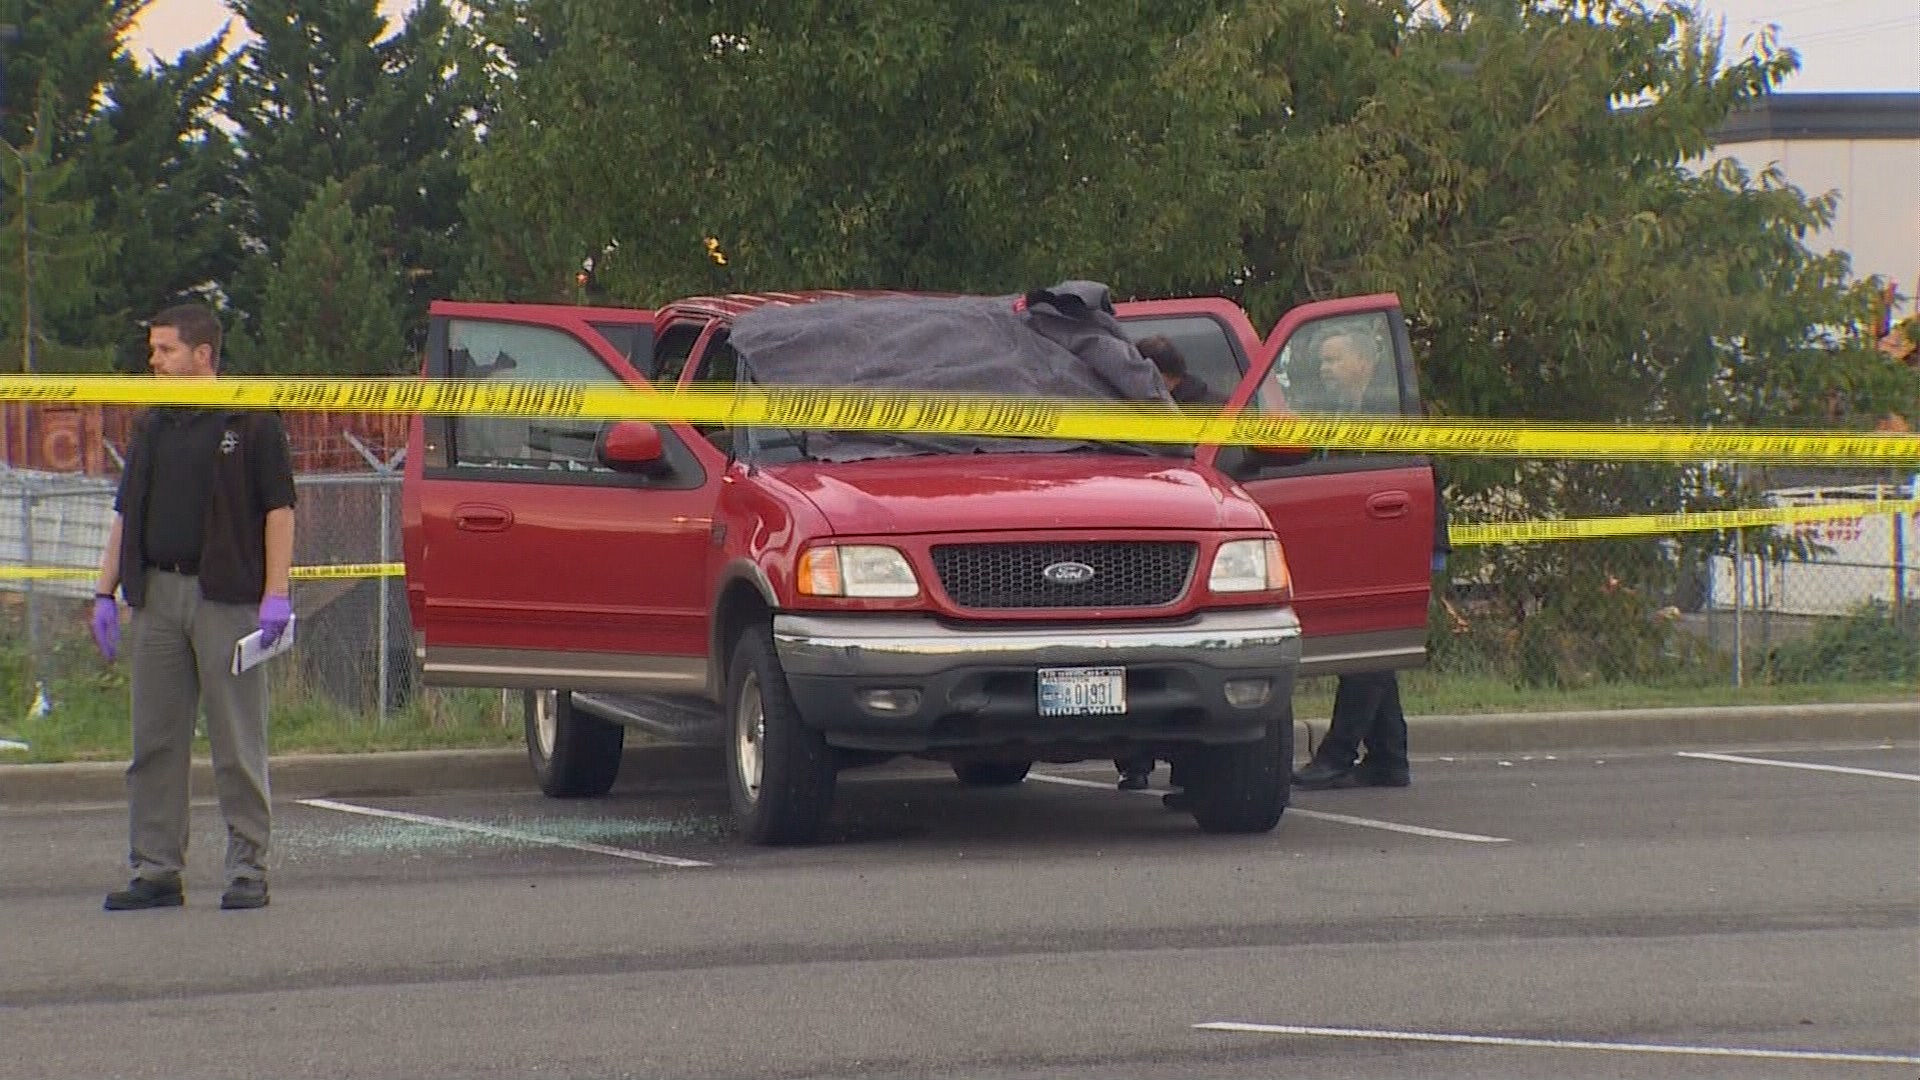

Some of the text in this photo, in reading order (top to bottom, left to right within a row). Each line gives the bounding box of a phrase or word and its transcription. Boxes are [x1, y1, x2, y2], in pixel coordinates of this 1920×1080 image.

[761, 387, 832, 419] CROSS
[829, 391, 876, 423] NOT
[878, 394, 911, 426] DO
[909, 396, 961, 430] LINE
